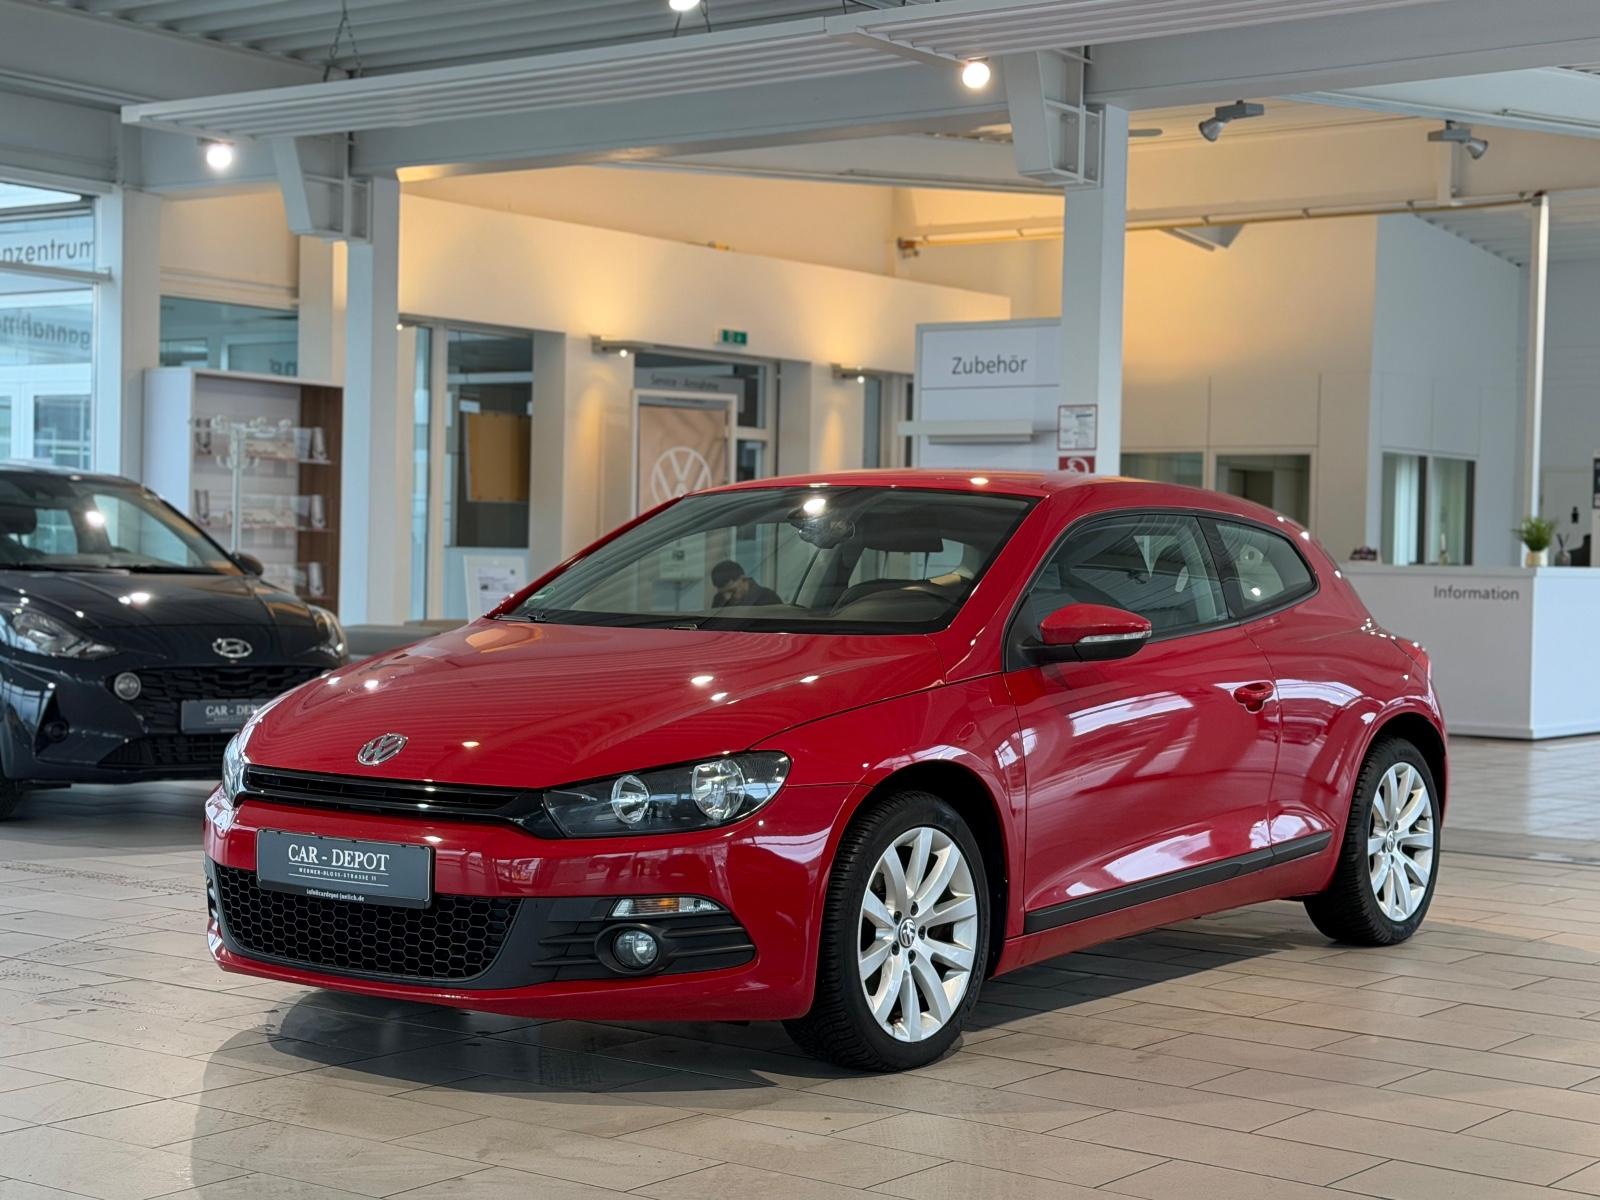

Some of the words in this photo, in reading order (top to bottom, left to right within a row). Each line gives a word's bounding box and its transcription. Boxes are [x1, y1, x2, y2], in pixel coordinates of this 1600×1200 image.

[951, 354, 1028, 375] Zubehör
[1433, 585, 1520, 600] Information
[205, 705, 229, 717] CAR
[288, 844, 319, 864] CAR
[331, 849, 390, 871] DEPOT
